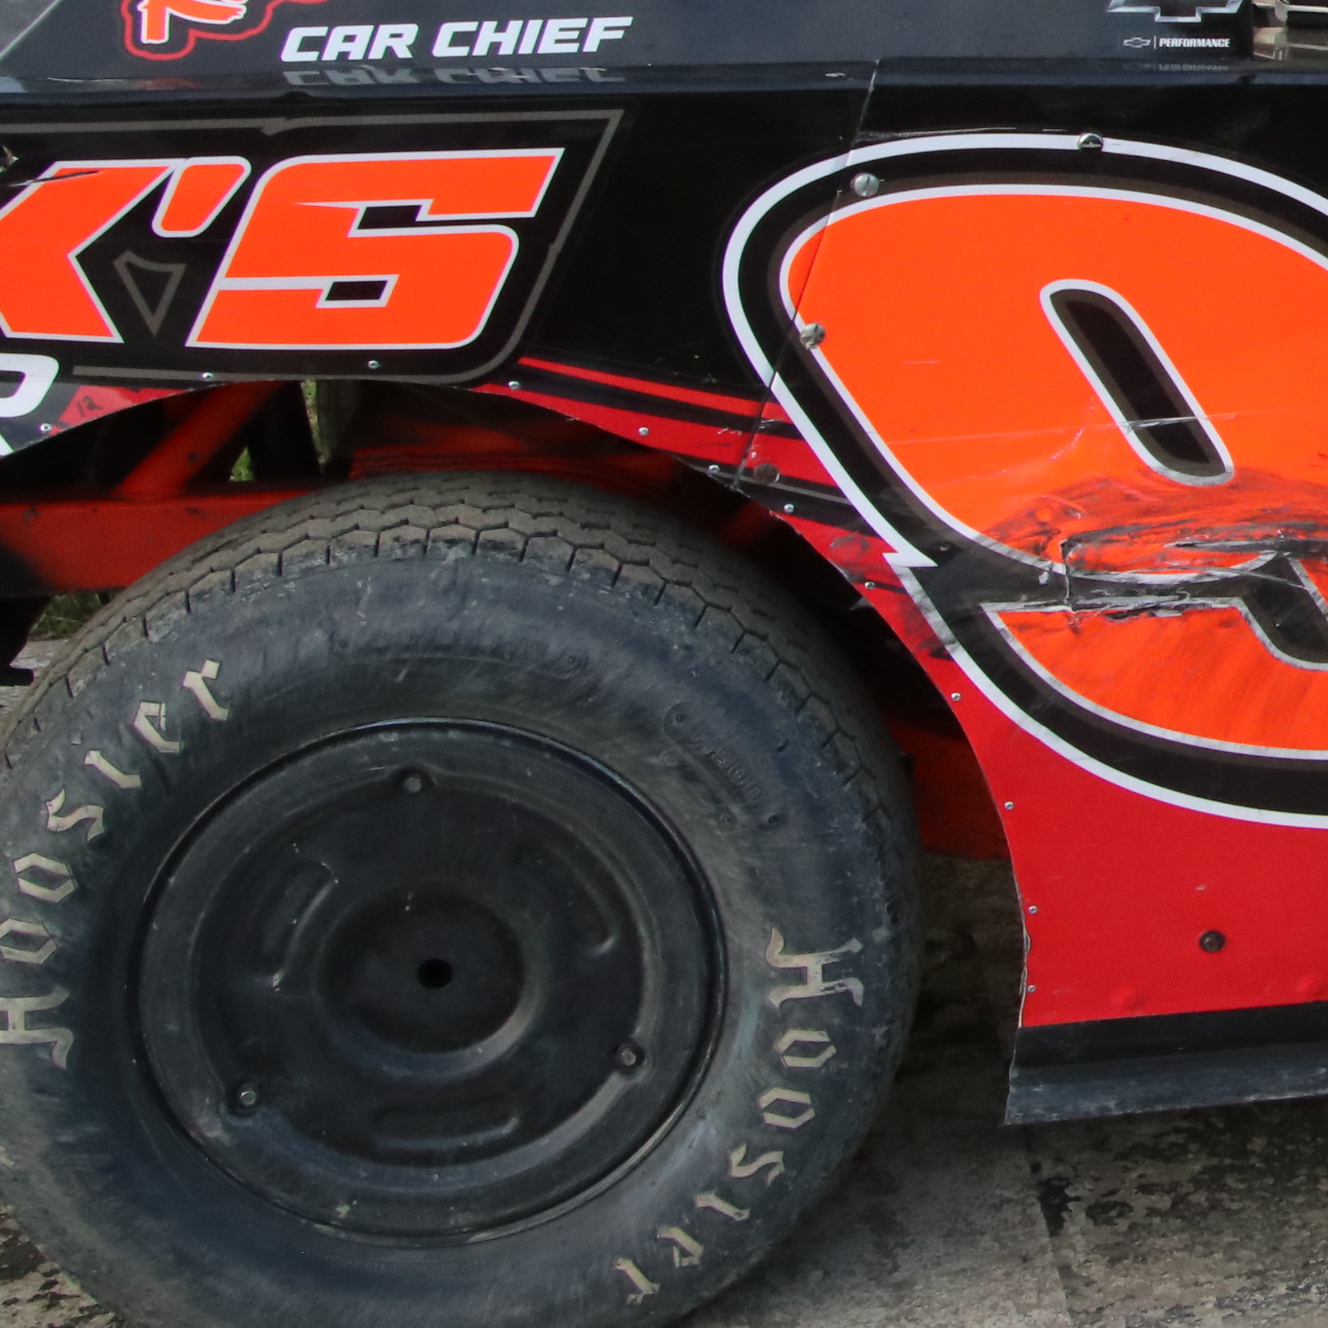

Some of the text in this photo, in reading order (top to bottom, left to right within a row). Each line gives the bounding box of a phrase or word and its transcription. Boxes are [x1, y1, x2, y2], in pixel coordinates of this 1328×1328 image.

[281, 16, 634, 63] CAR CHIEF
[1158, 37, 1231, 49] PERFORMANCE
